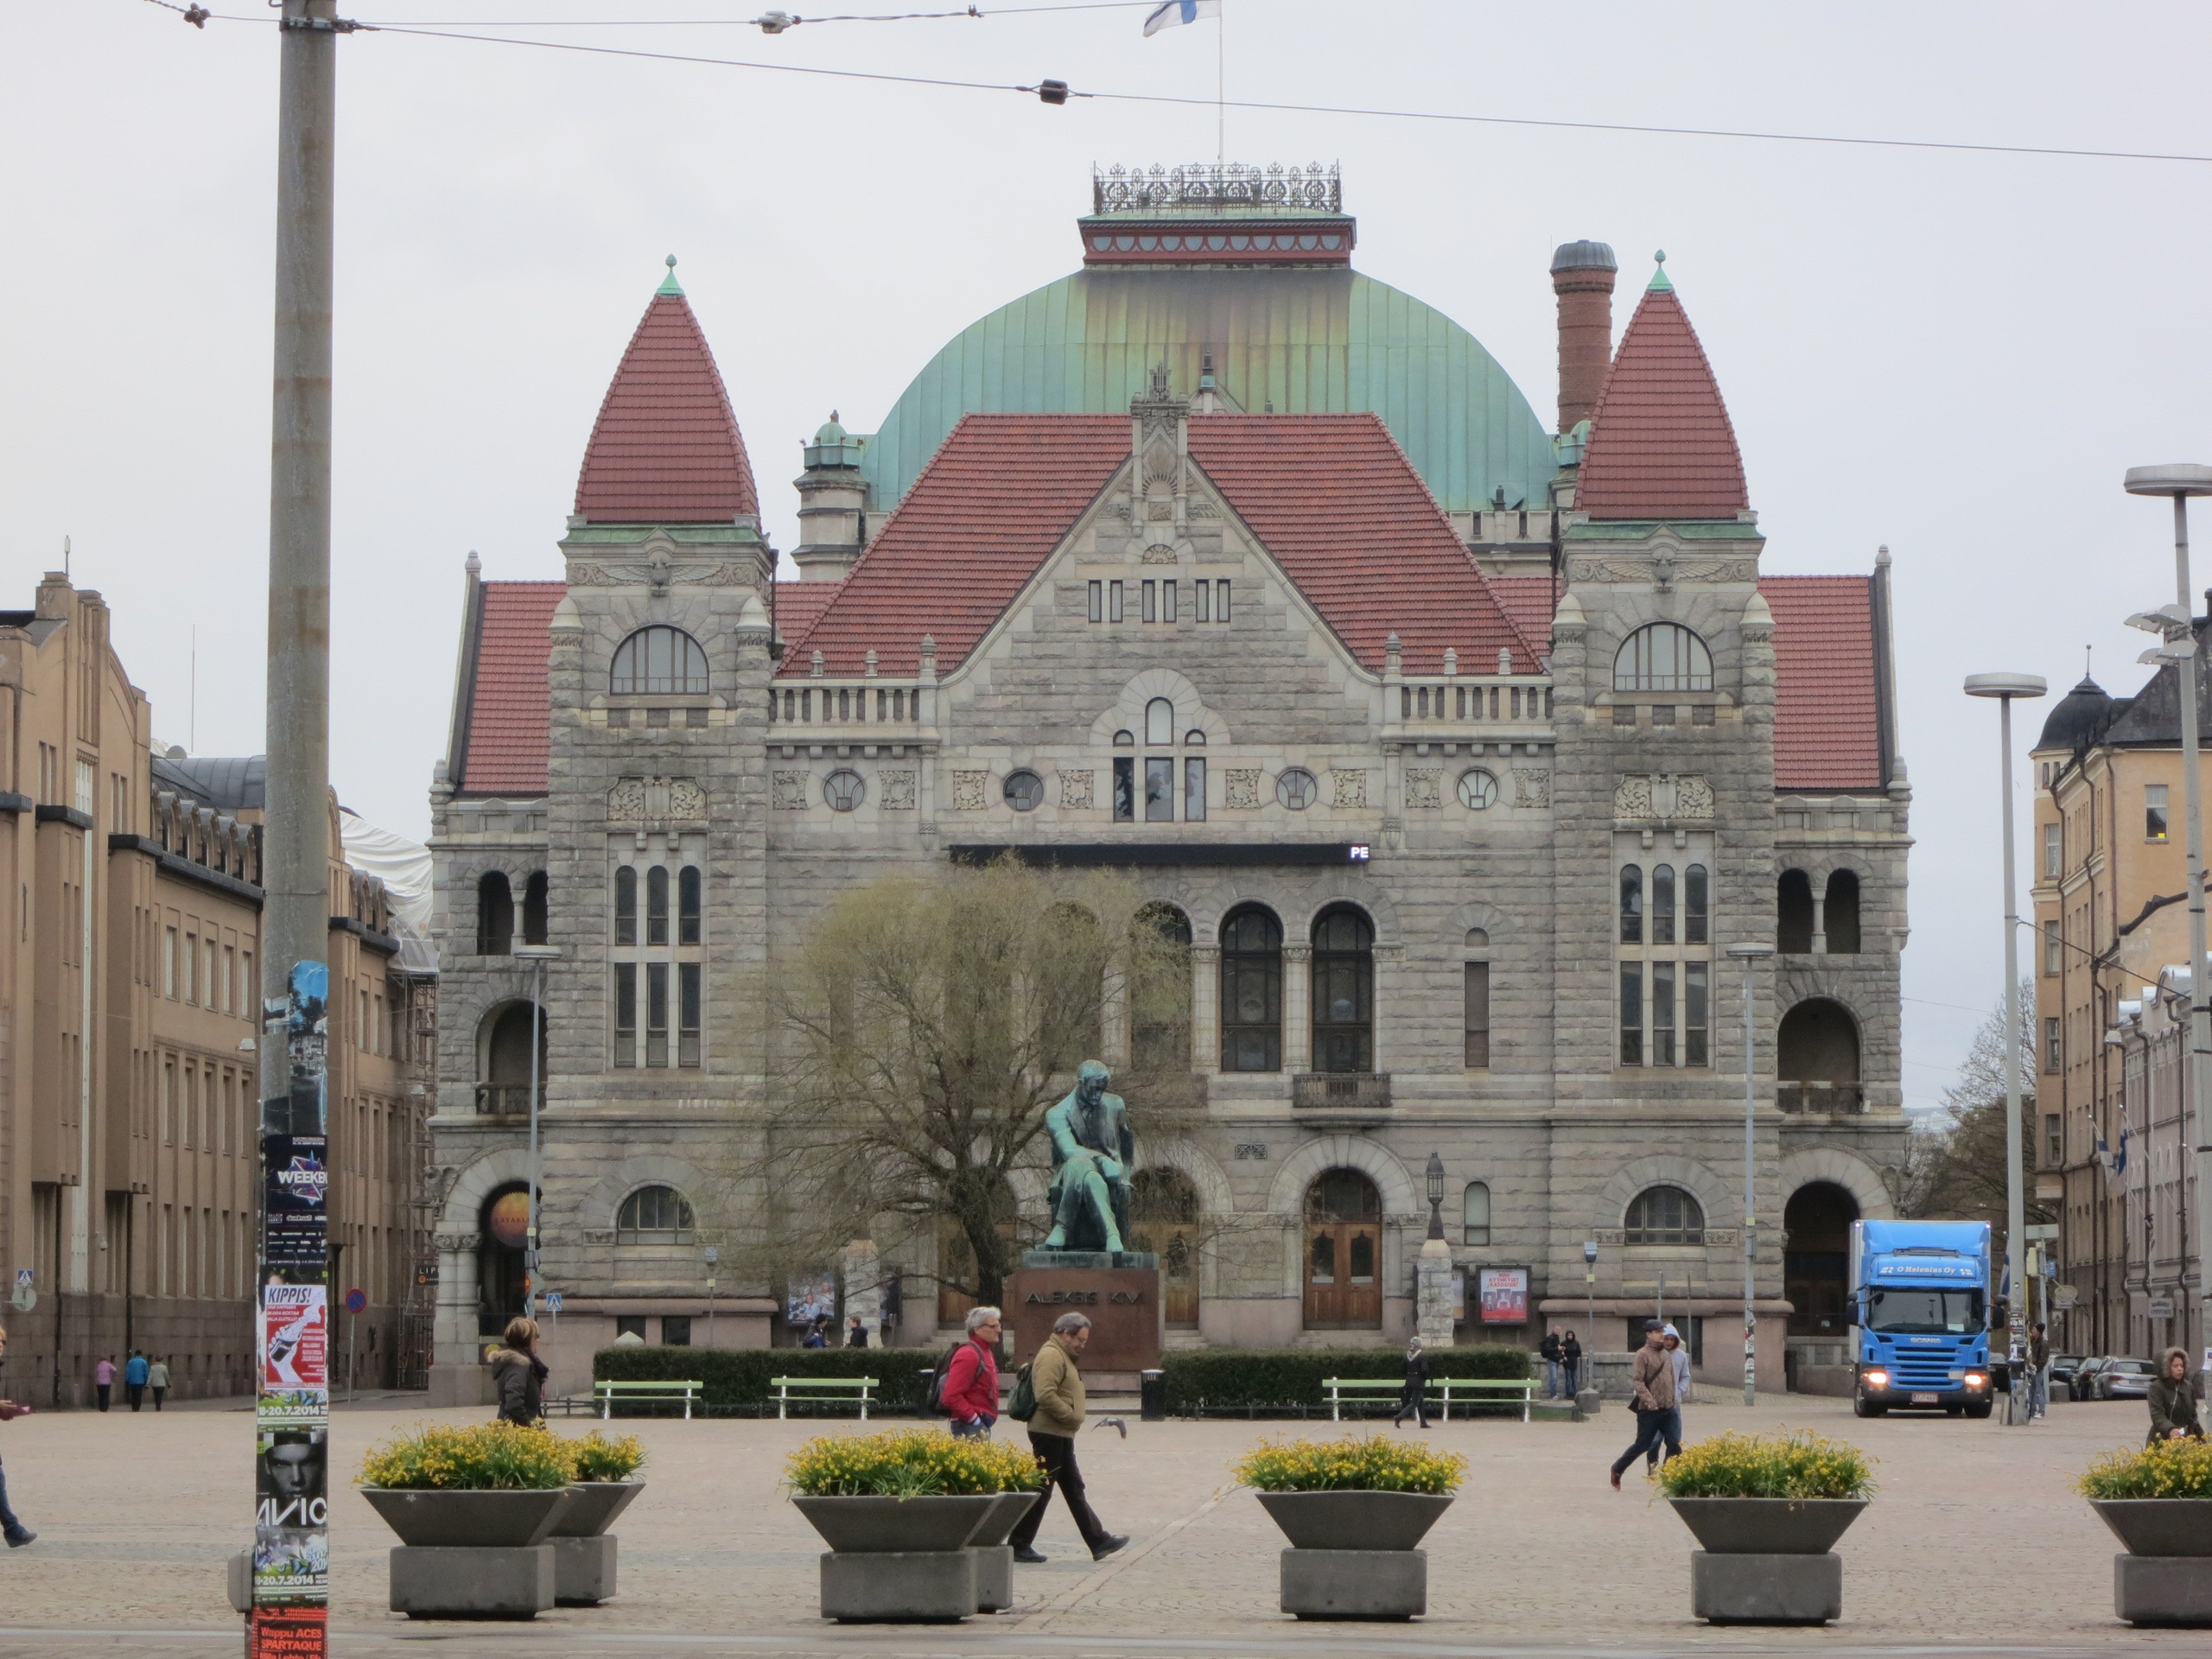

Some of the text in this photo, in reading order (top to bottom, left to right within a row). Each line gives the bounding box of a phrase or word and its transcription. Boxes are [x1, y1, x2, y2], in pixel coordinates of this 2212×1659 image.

[1351, 846, 1370, 859] PE
[1905, 1265, 1942, 1274] Helenius
[1943, 1267, 1956, 1276] Oy
[268, 1287, 312, 1304] KIPPIS!
[1026, 1291, 1098, 1305] ALEKSIS
[261, 1627, 322, 1639] Wappu ACES
[261, 1639, 321, 1650] SPARTAQUE
